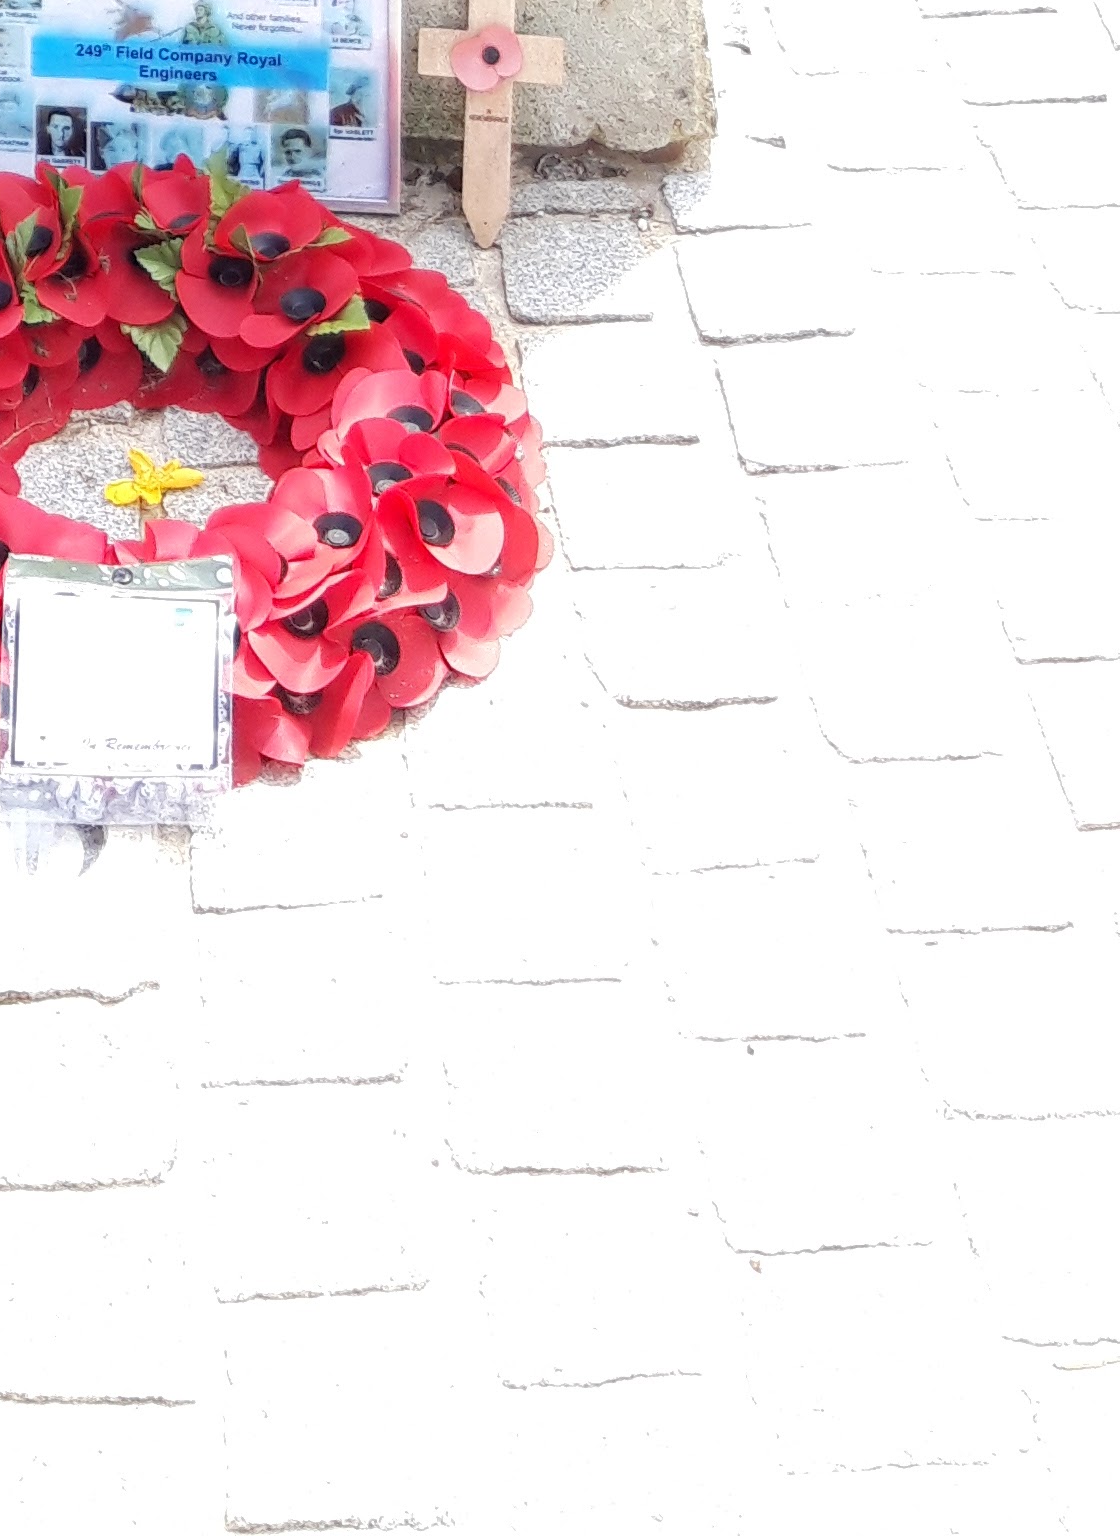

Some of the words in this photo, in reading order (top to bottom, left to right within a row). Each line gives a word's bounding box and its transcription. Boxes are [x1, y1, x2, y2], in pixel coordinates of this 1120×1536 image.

[227, 12, 247, 21] And
[250, 12, 268, 22] other
[232, 23, 257, 31] Never
[75, 44, 111, 57] 249th
[116, 48, 153, 60] Field
[158, 48, 232, 66] Company
[238, 52, 282, 66] Royal
[139, 65, 217, 83] Engineers
